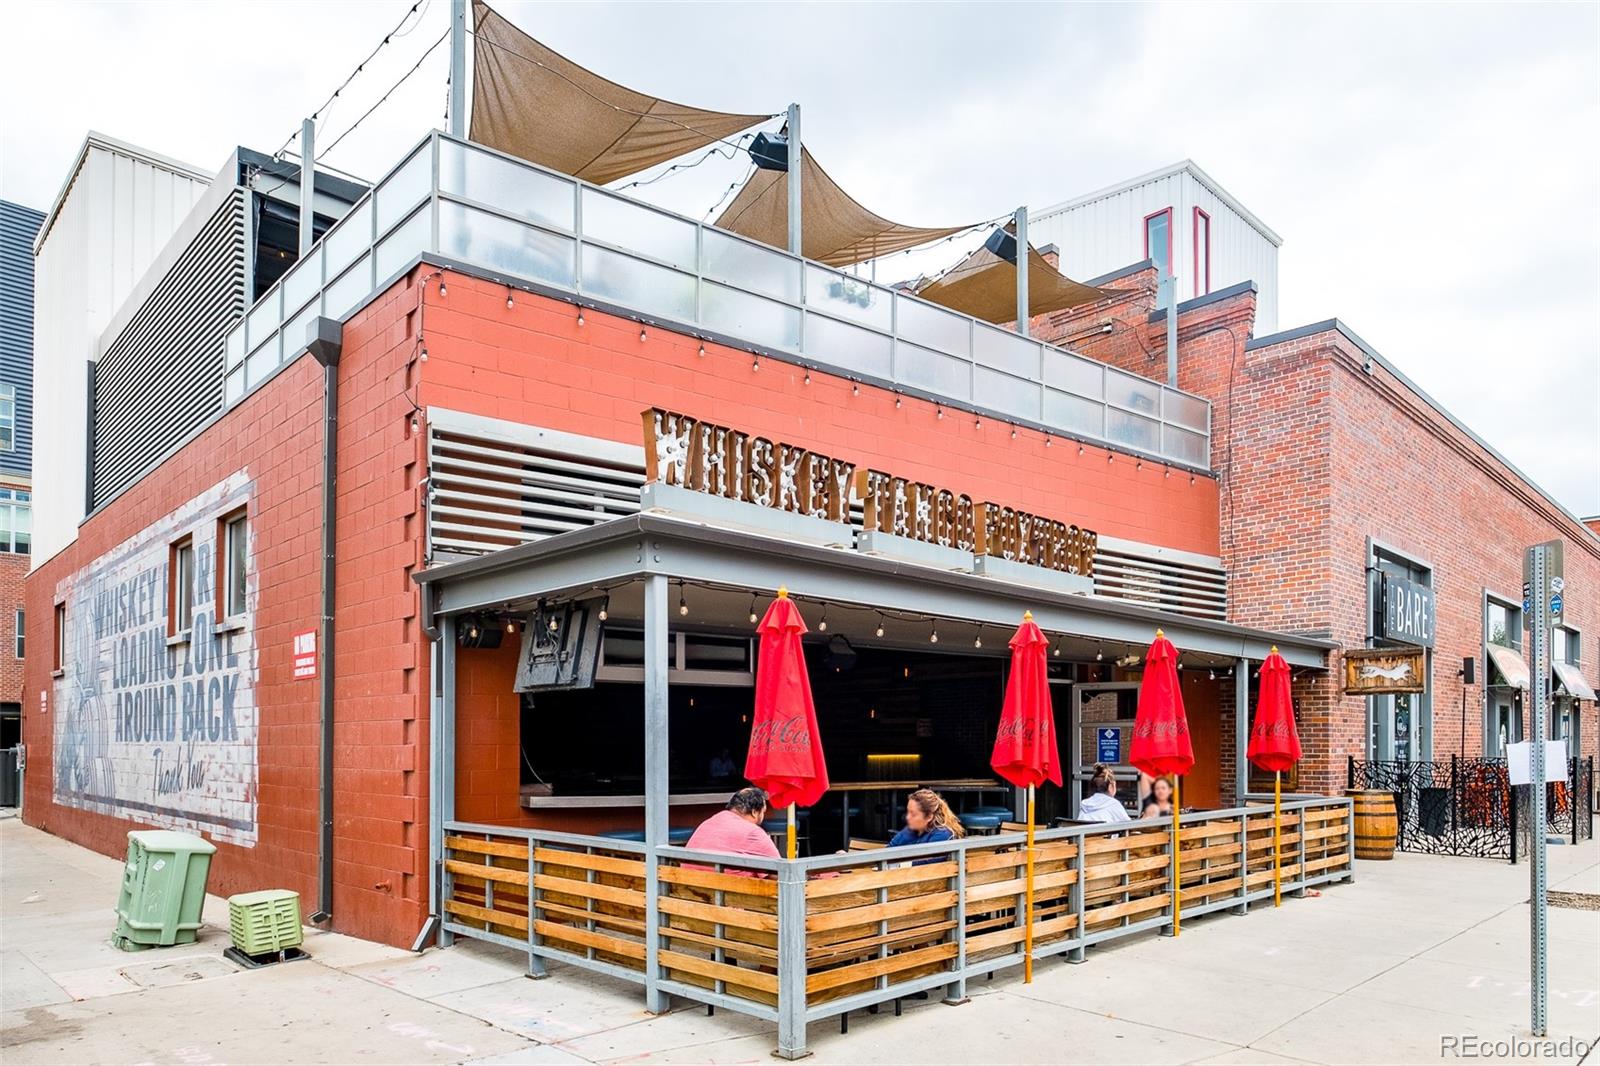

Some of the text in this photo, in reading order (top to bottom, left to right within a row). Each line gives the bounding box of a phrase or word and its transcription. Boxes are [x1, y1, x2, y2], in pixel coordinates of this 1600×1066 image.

[641, 406, 1099, 578] WHISKEY TANGO FOXTROT
[94, 567, 158, 641] WHISKEY
[1396, 586, 1428, 639] BARE
[115, 673, 239, 742] AROUND BACK
[152, 745, 183, 803] Thank
